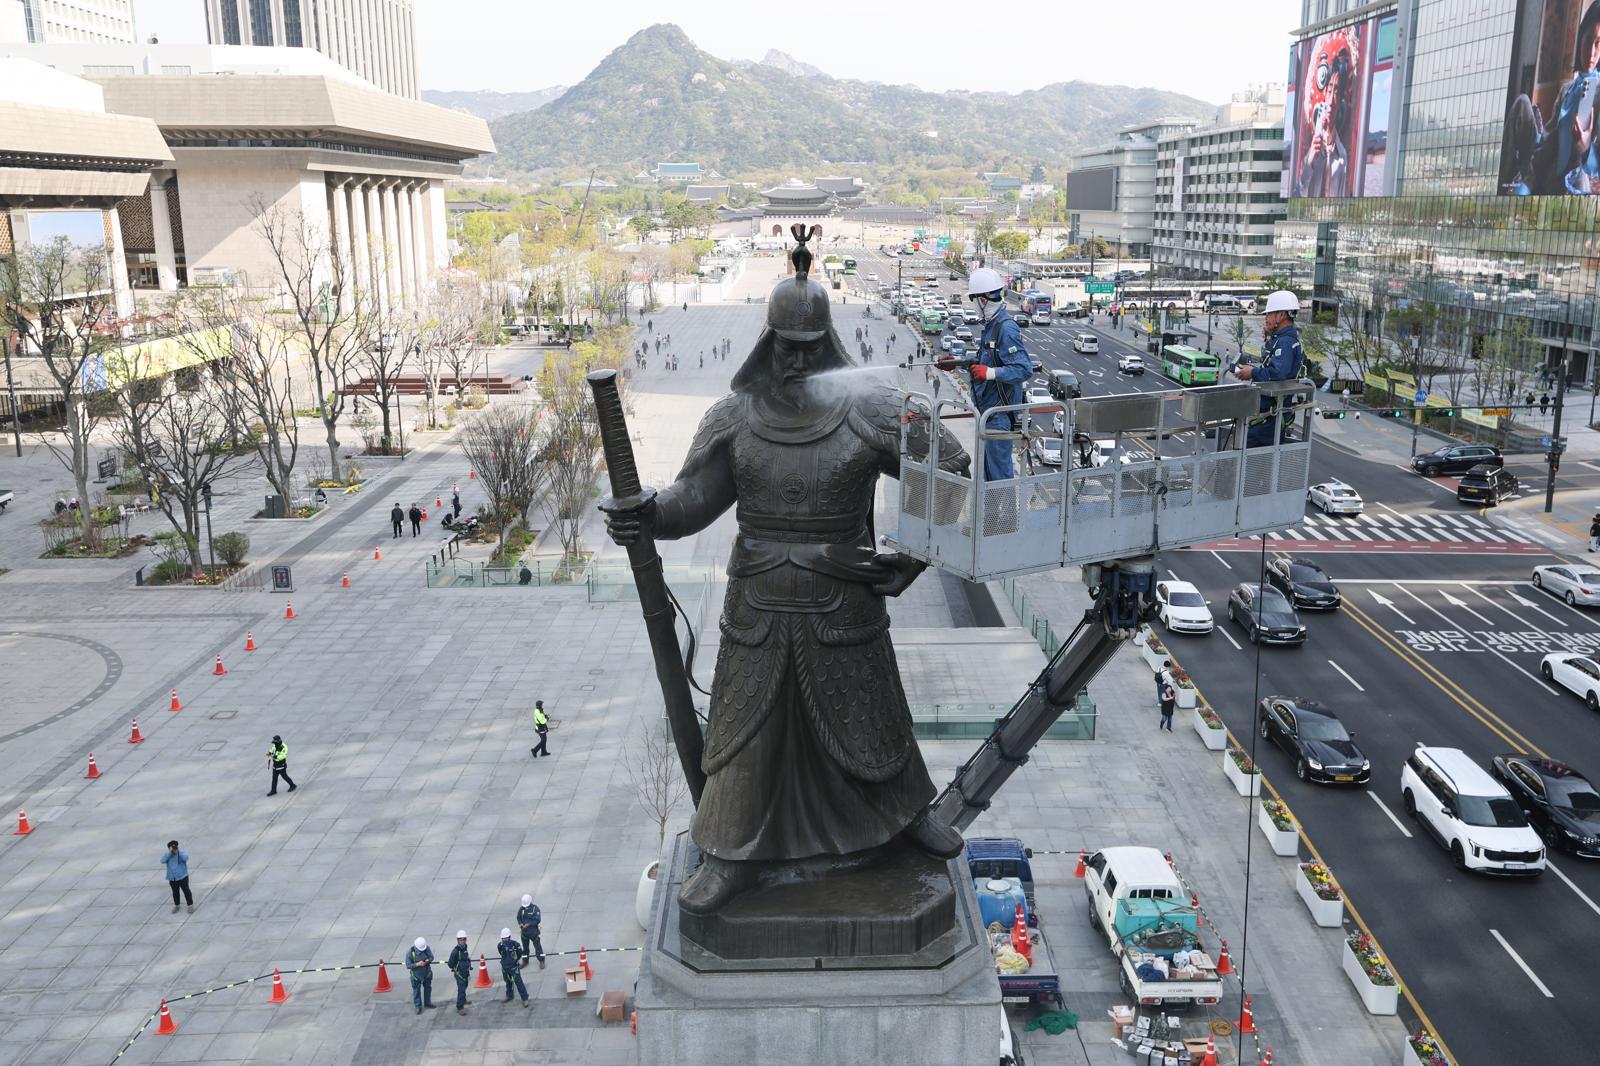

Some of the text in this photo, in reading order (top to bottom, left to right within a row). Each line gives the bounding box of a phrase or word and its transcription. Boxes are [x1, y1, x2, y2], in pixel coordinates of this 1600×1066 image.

[1394, 630, 1486, 652] 광화문
[1473, 631, 1569, 653] 광화문
[1549, 632, 1600, 654] 광화
